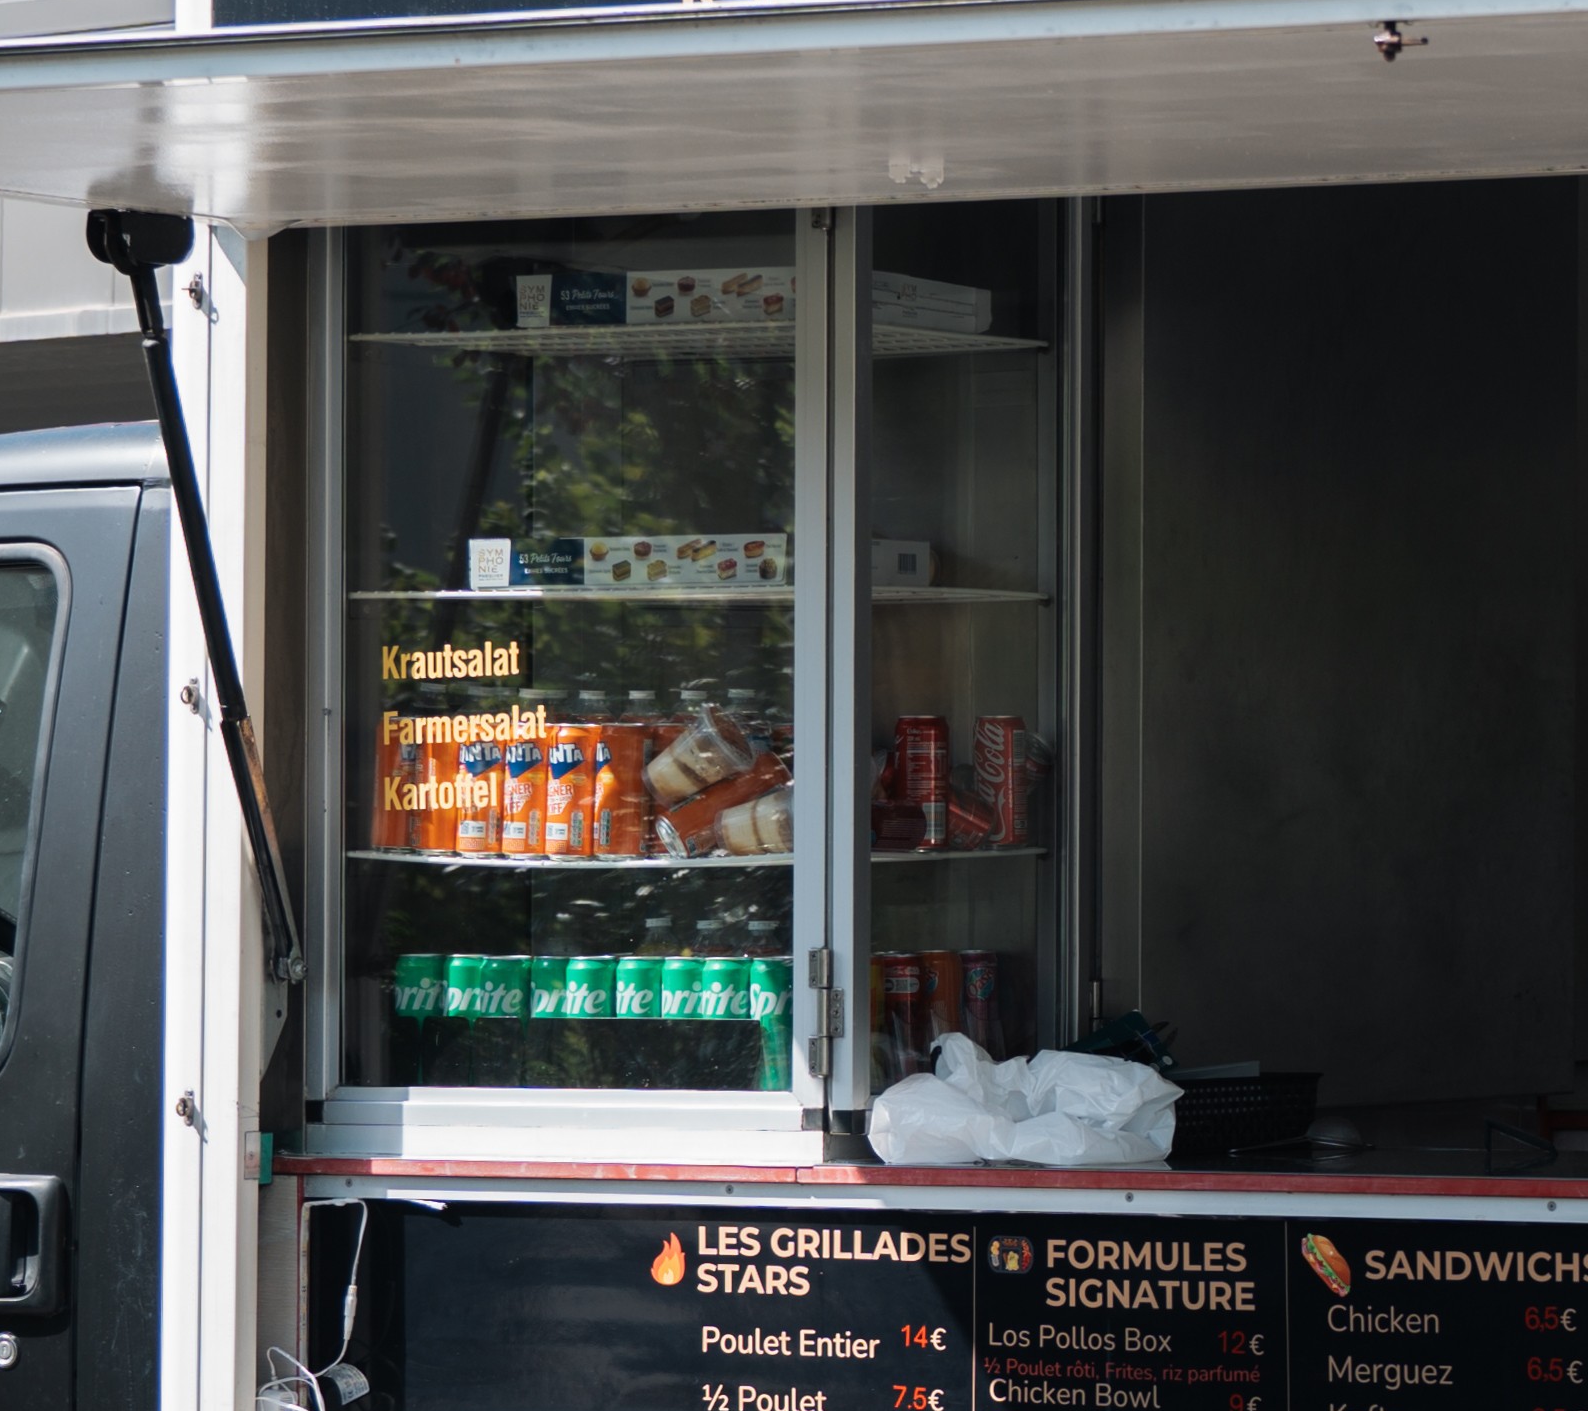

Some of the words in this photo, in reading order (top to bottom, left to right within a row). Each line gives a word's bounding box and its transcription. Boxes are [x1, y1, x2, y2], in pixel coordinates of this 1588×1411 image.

[382, 641, 520, 680] Krautsalat
[383, 704, 547, 746] Farmersalat
[384, 772, 498, 811] Kartoffel
[698, 1224, 761, 1257] LES
[770, 1227, 971, 1263] GRILLADES
[1047, 1239, 1247, 1272] FORMULES
[697, 1263, 810, 1296] STARS
[1046, 1277, 1255, 1311] SIGNATURE
[1328, 1304, 1439, 1333] Chicken
[702, 1326, 792, 1356] Poulet
[799, 1329, 881, 1359] Entier
[901, 1324, 947, 1351] 14€
[989, 1322, 1030, 1347] Los
[1039, 1324, 1115, 1351] Pollos
[1125, 1327, 1171, 1352] Box
[1006, 1358, 1061, 1377] Poulet
[1067, 1360, 1099, 1380] rôti,
[1105, 1361, 1156, 1381] Frites,
[1162, 1364, 1183, 1381] riz
[1188, 1365, 1260, 1384] parfumé
[1328, 1355, 1453, 1390] Merguez
[702, 1384, 729, 1411] ½
[989, 1378, 1085, 1405] Chicken
[1096, 1383, 1160, 1408] Bowl
